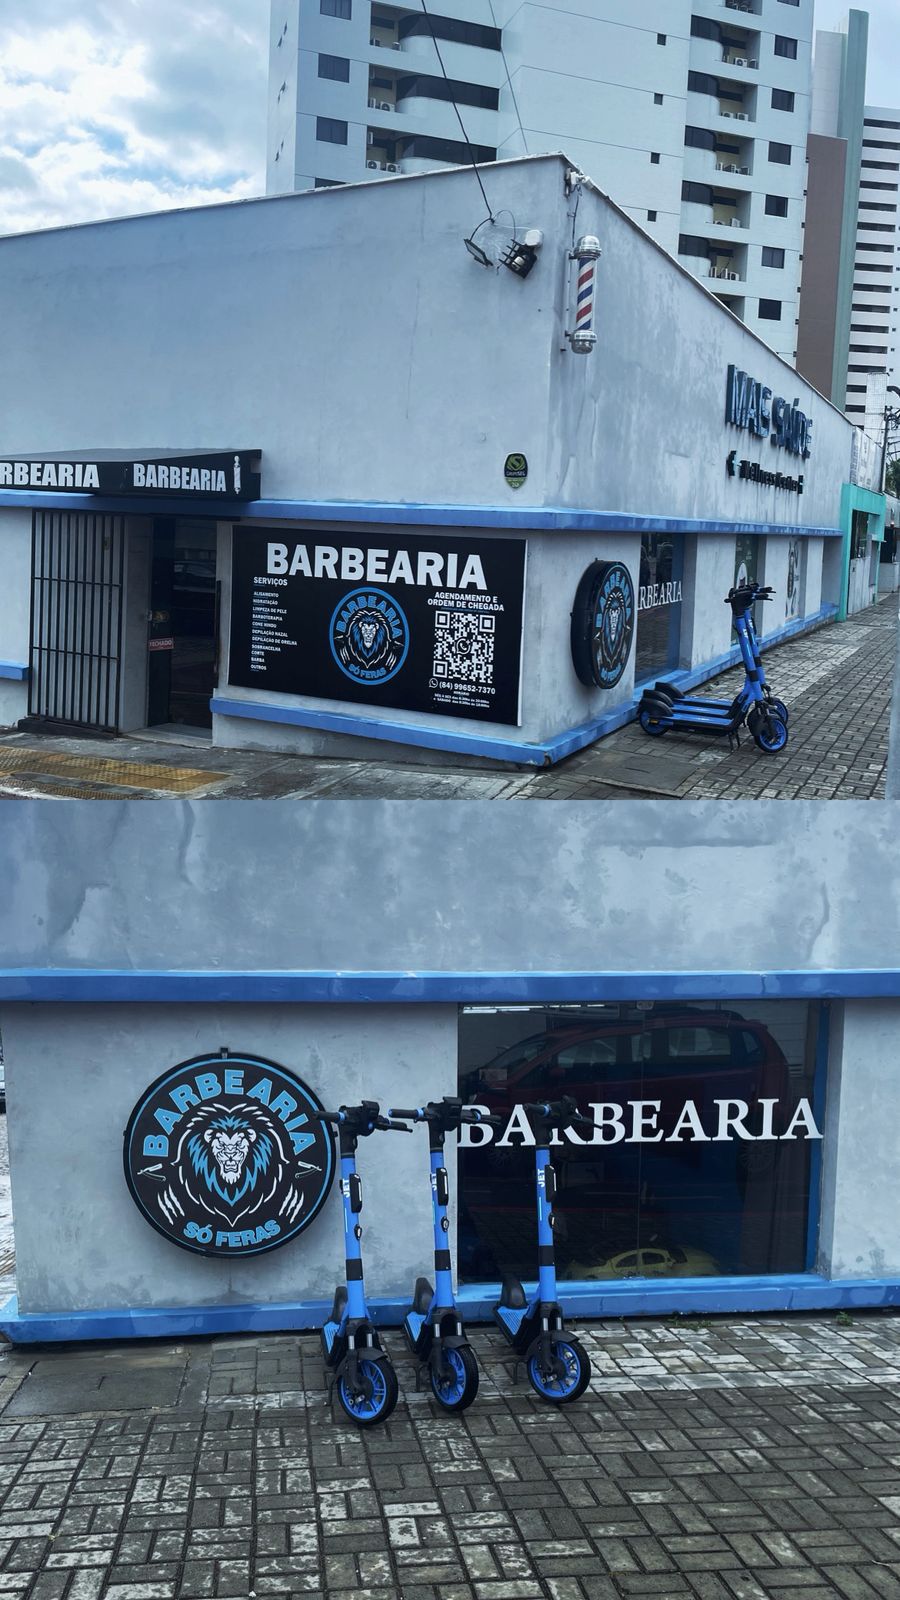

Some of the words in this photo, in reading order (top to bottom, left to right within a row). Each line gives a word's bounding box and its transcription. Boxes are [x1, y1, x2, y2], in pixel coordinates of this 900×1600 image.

[133, 463, 227, 492] BARBEARIA
[267, 542, 488, 590] BARBEARIA
[253, 576, 288, 587] SERVIÇOS
[427, 599, 454, 607] ORDEM
[469, 603, 504, 611] CHEGADA
[435, 592, 491, 603] AGENDAMENTO
[336, 595, 403, 639] BARBEARIA
[360, 667, 387, 679] FERAS
[439, 681, 453, 690] (84)
[454, 683, 496, 695] 99652-7370
[143, 1069, 316, 1157] BARBEARIA
[183, 1221, 213, 1244] SÓ
[215, 1219, 281, 1247] FERAS
